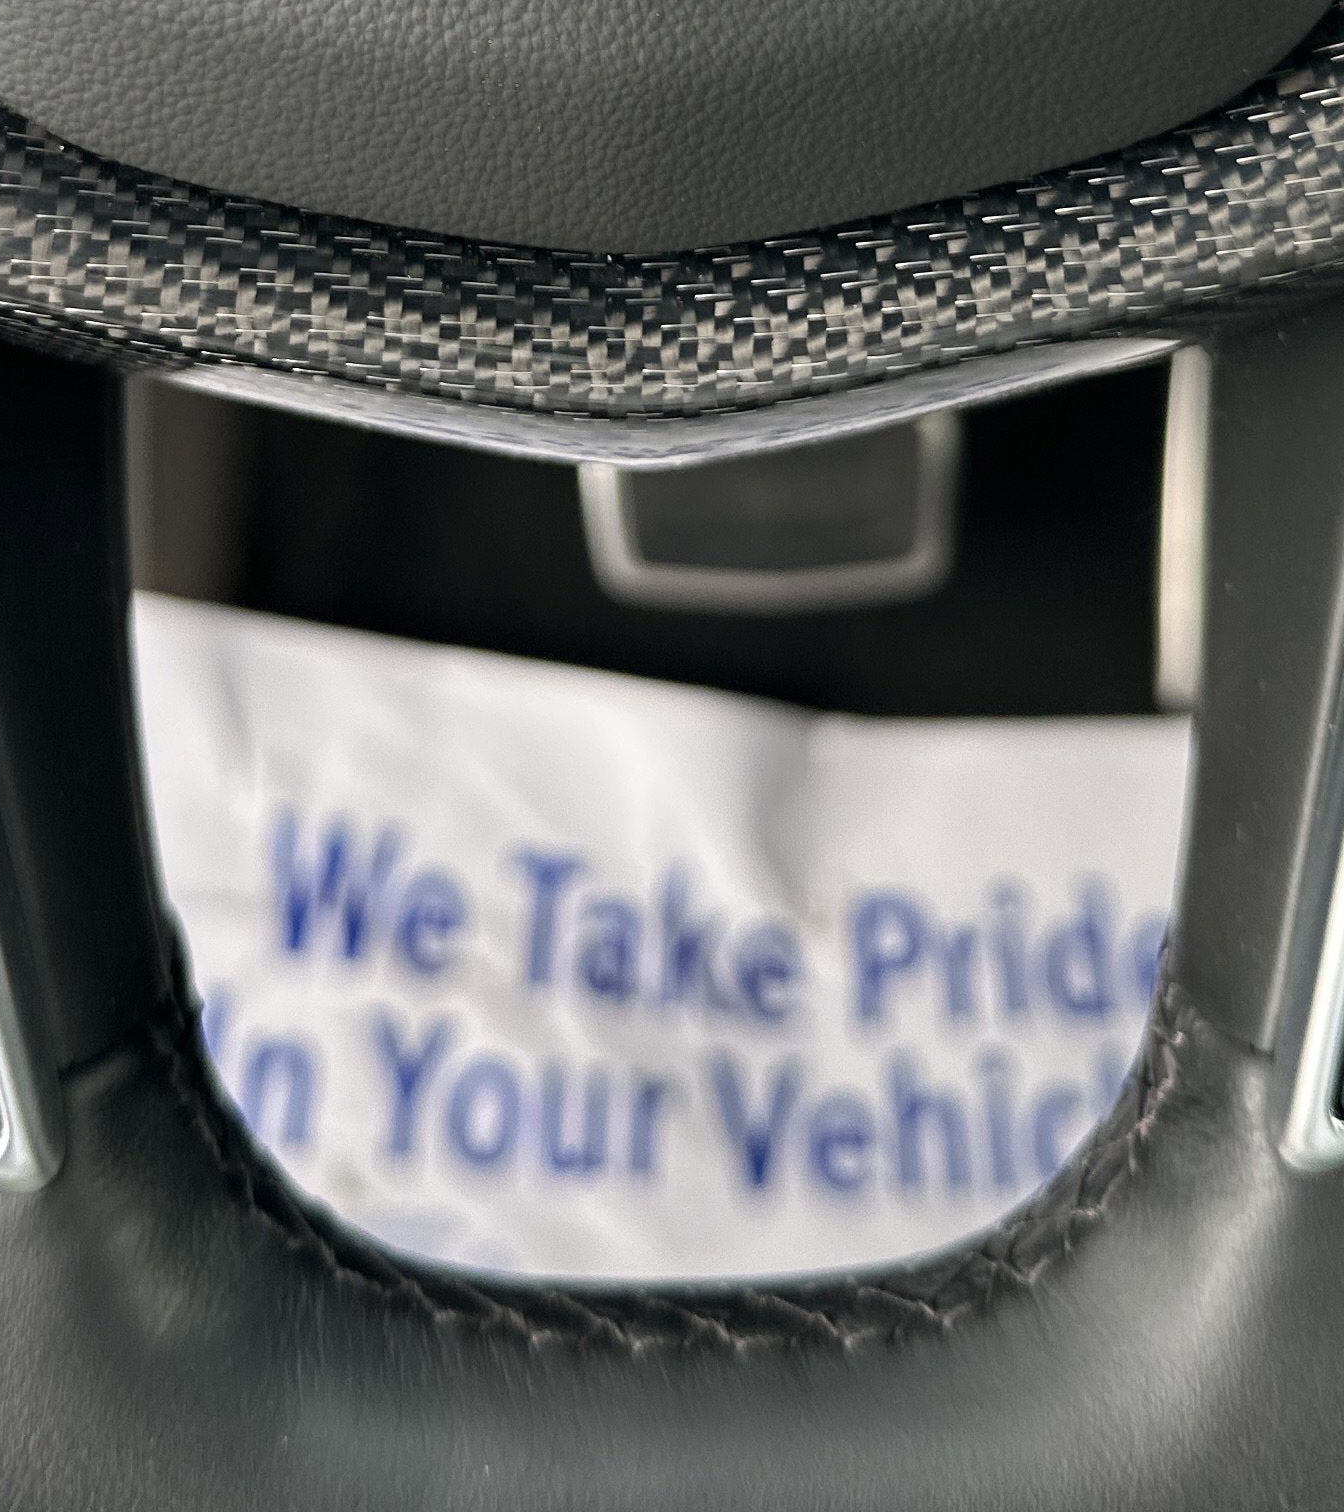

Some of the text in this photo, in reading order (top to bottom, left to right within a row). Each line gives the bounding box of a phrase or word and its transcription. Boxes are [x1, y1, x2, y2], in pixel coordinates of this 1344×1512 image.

[266, 800, 466, 983] We
[504, 833, 806, 1026] Take
[366, 998, 684, 1183] Your
